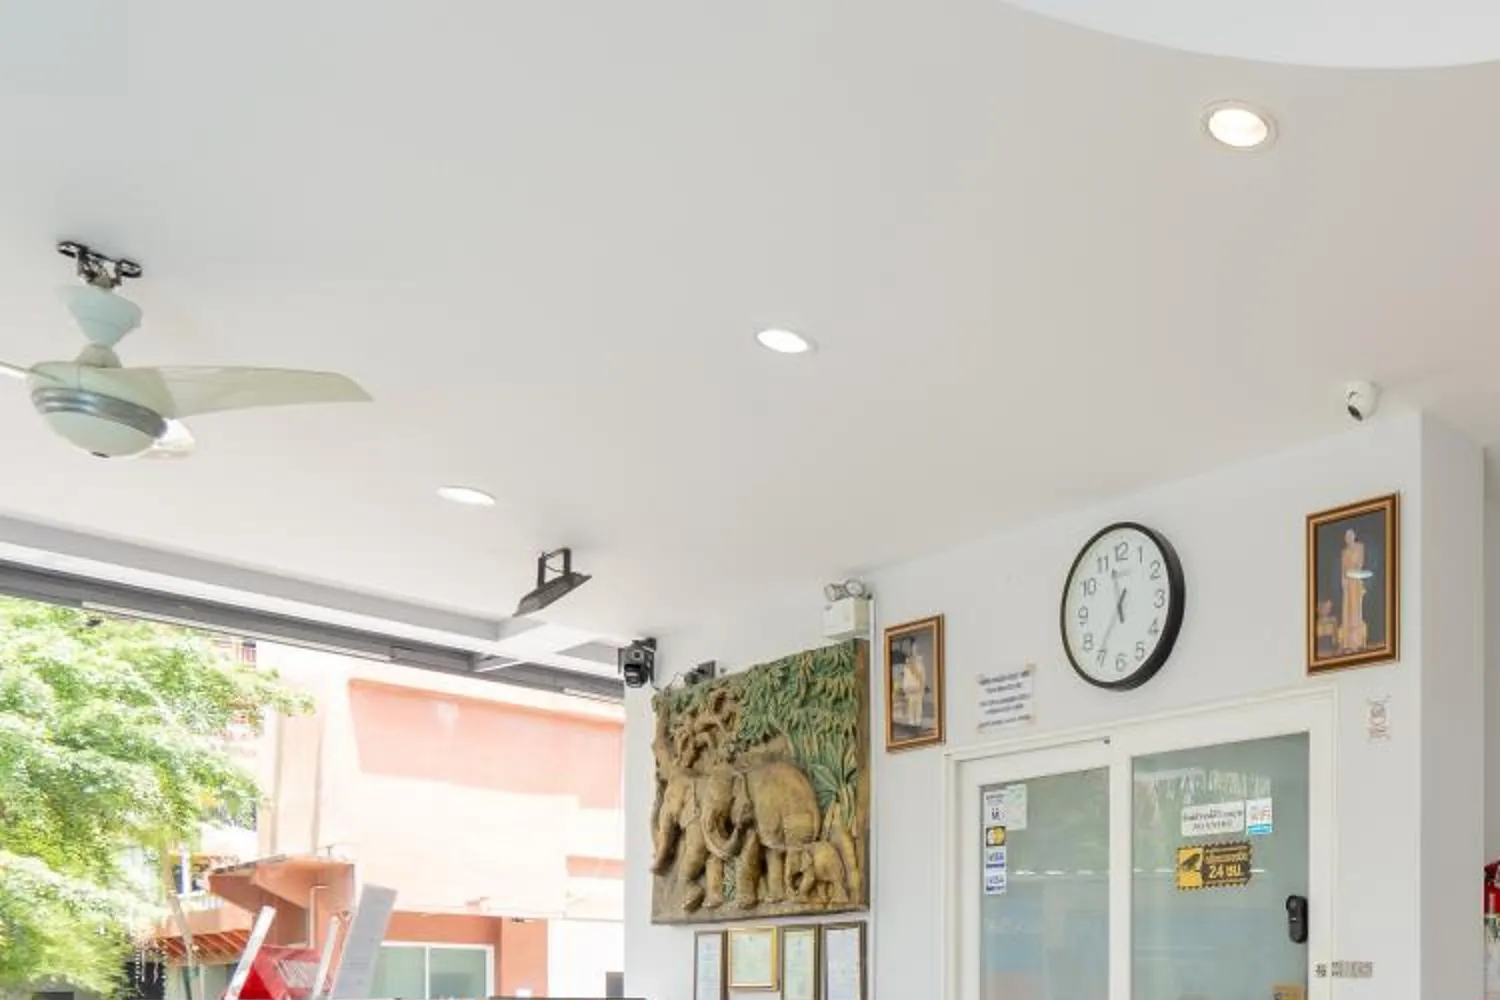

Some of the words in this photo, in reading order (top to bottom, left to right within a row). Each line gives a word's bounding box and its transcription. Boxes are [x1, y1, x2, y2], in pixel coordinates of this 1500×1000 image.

[1114, 541, 1129, 562] 12
[1097, 554, 1110, 574] 11
[1150, 560, 1161, 580] 2
[1081, 577, 1097, 597] 10
[1153, 588, 1166, 609] 3
[1078, 606, 1089, 627] 9
[1148, 618, 1160, 636] 4
[1083, 633, 1094, 652] 8
[1135, 641, 1146, 662] 5
[1115, 652, 1127, 673] 6
[1208, 863, 1225, 879] 24
